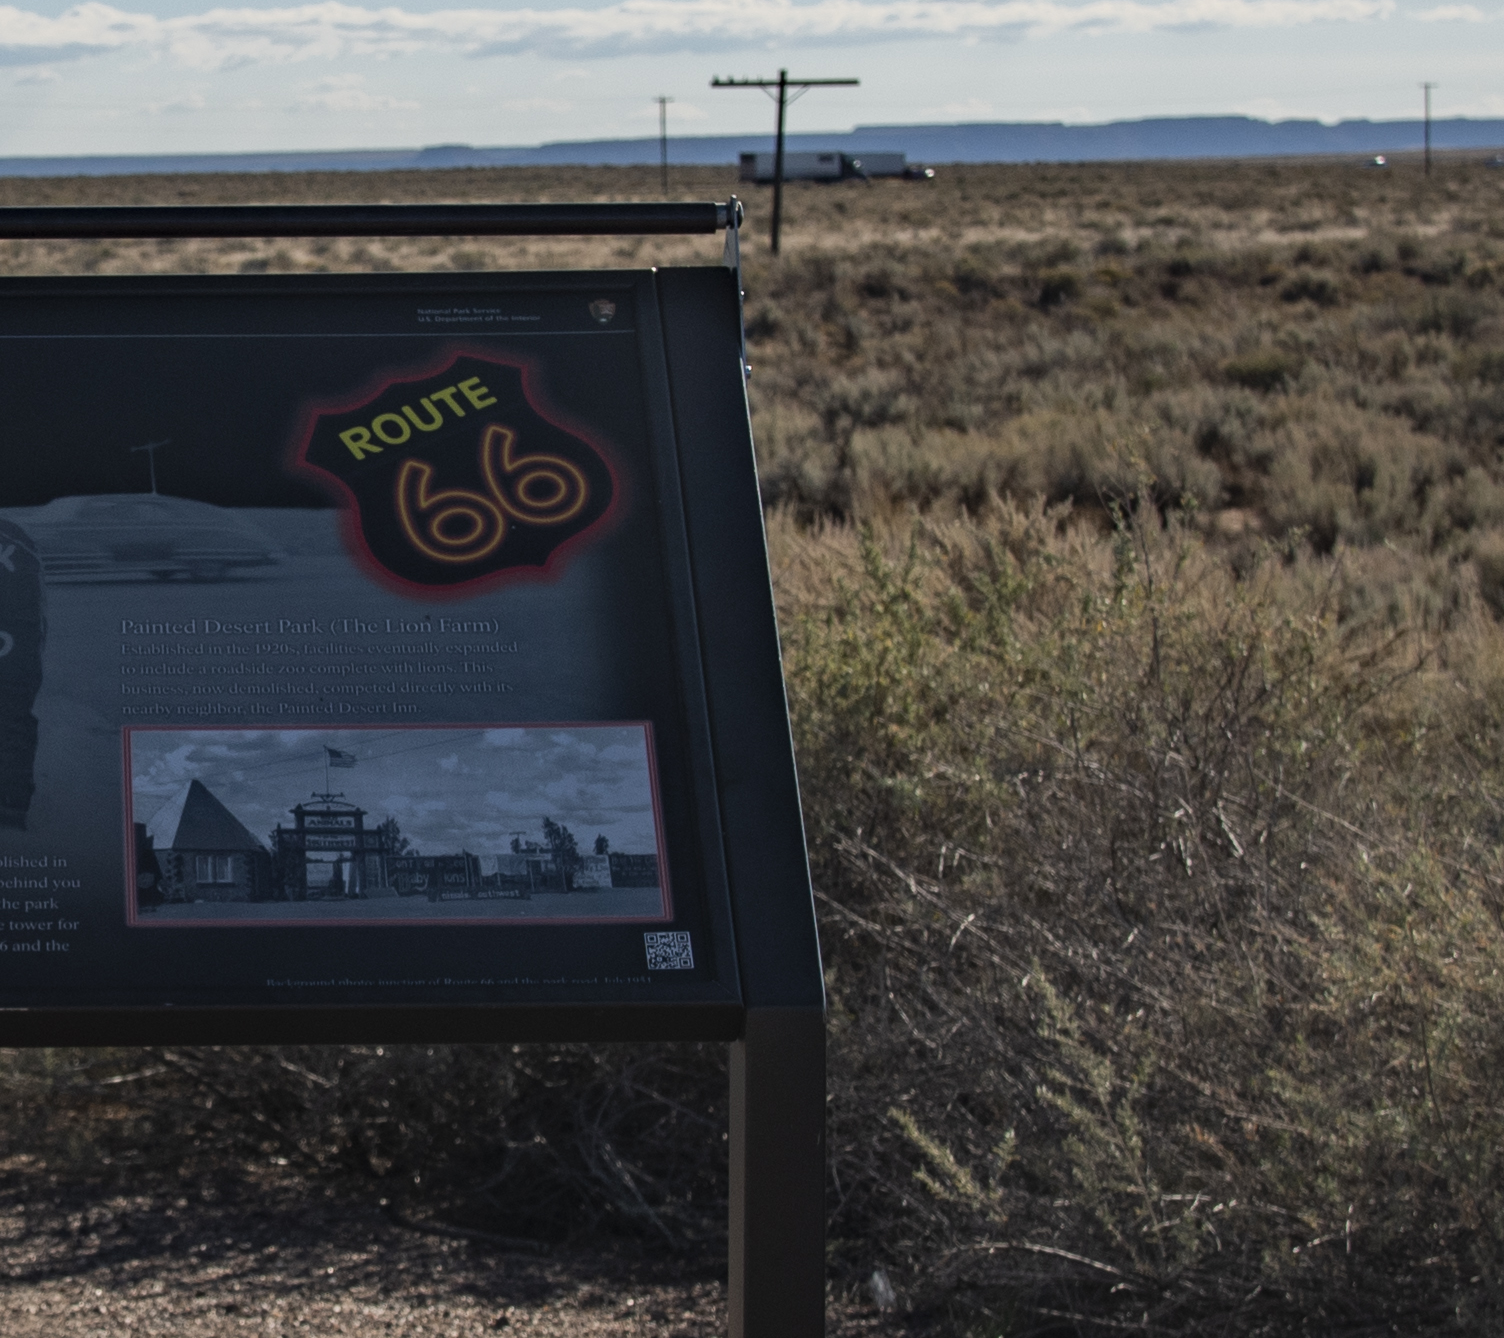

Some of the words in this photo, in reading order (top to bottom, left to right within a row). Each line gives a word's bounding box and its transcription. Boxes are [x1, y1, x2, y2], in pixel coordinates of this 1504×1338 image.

[417, 315, 432, 323] U.S.
[435, 315, 483, 323] Department
[511, 314, 541, 322] Interior
[339, 376, 497, 460] ROUTE
[397, 425, 586, 561] 66
[121, 619, 197, 635] Painted
[203, 619, 272, 635] Desert
[278, 618, 324, 634] Park
[330, 617, 378, 636] (The
[385, 618, 432, 634] Lion
[440, 617, 500, 634] Farm)
[121, 643, 204, 655] Established
[208, 643, 222, 655] in
[226, 643, 250, 655] the
[255, 642, 300, 656] 1920s,
[304, 642, 363, 655] facilities
[367, 642, 441, 656] eventually
[446, 642, 518, 656] expanded
[121, 665, 136, 675] to
[140, 663, 194, 675] include
[198, 666, 207, 675] a
[211, 662, 273, 675] roadside
[278, 665, 305, 674] zoo
[309, 663, 377, 677] complete
[381, 662, 413, 674] with
[417, 662, 457, 674] lions.
[461, 661, 494, 673] This
[121, 683, 188, 696] business,
[192, 685, 225, 695] now
[229, 683, 319, 696] demolished,
[323, 682, 395, 696] competed
[400, 681, 456, 696] directly
[459, 681, 492, 693] with
[496, 681, 514, 693] its
[122, 703, 172, 717] nearby
[177, 703, 246, 717] neighbor,
[250, 703, 273, 714] the
[278, 702, 333, 714] Painted
[339, 702, 388, 714] Desert
[392, 702, 422, 714] Inn.
[52, 855, 68, 868] in
[52, 878, 81, 892] you
[25, 897, 59, 913] park
[9, 920, 53, 931] tower
[58, 917, 80, 931] for
[12, 939, 41, 952] and
[45, 939, 70, 952] the
